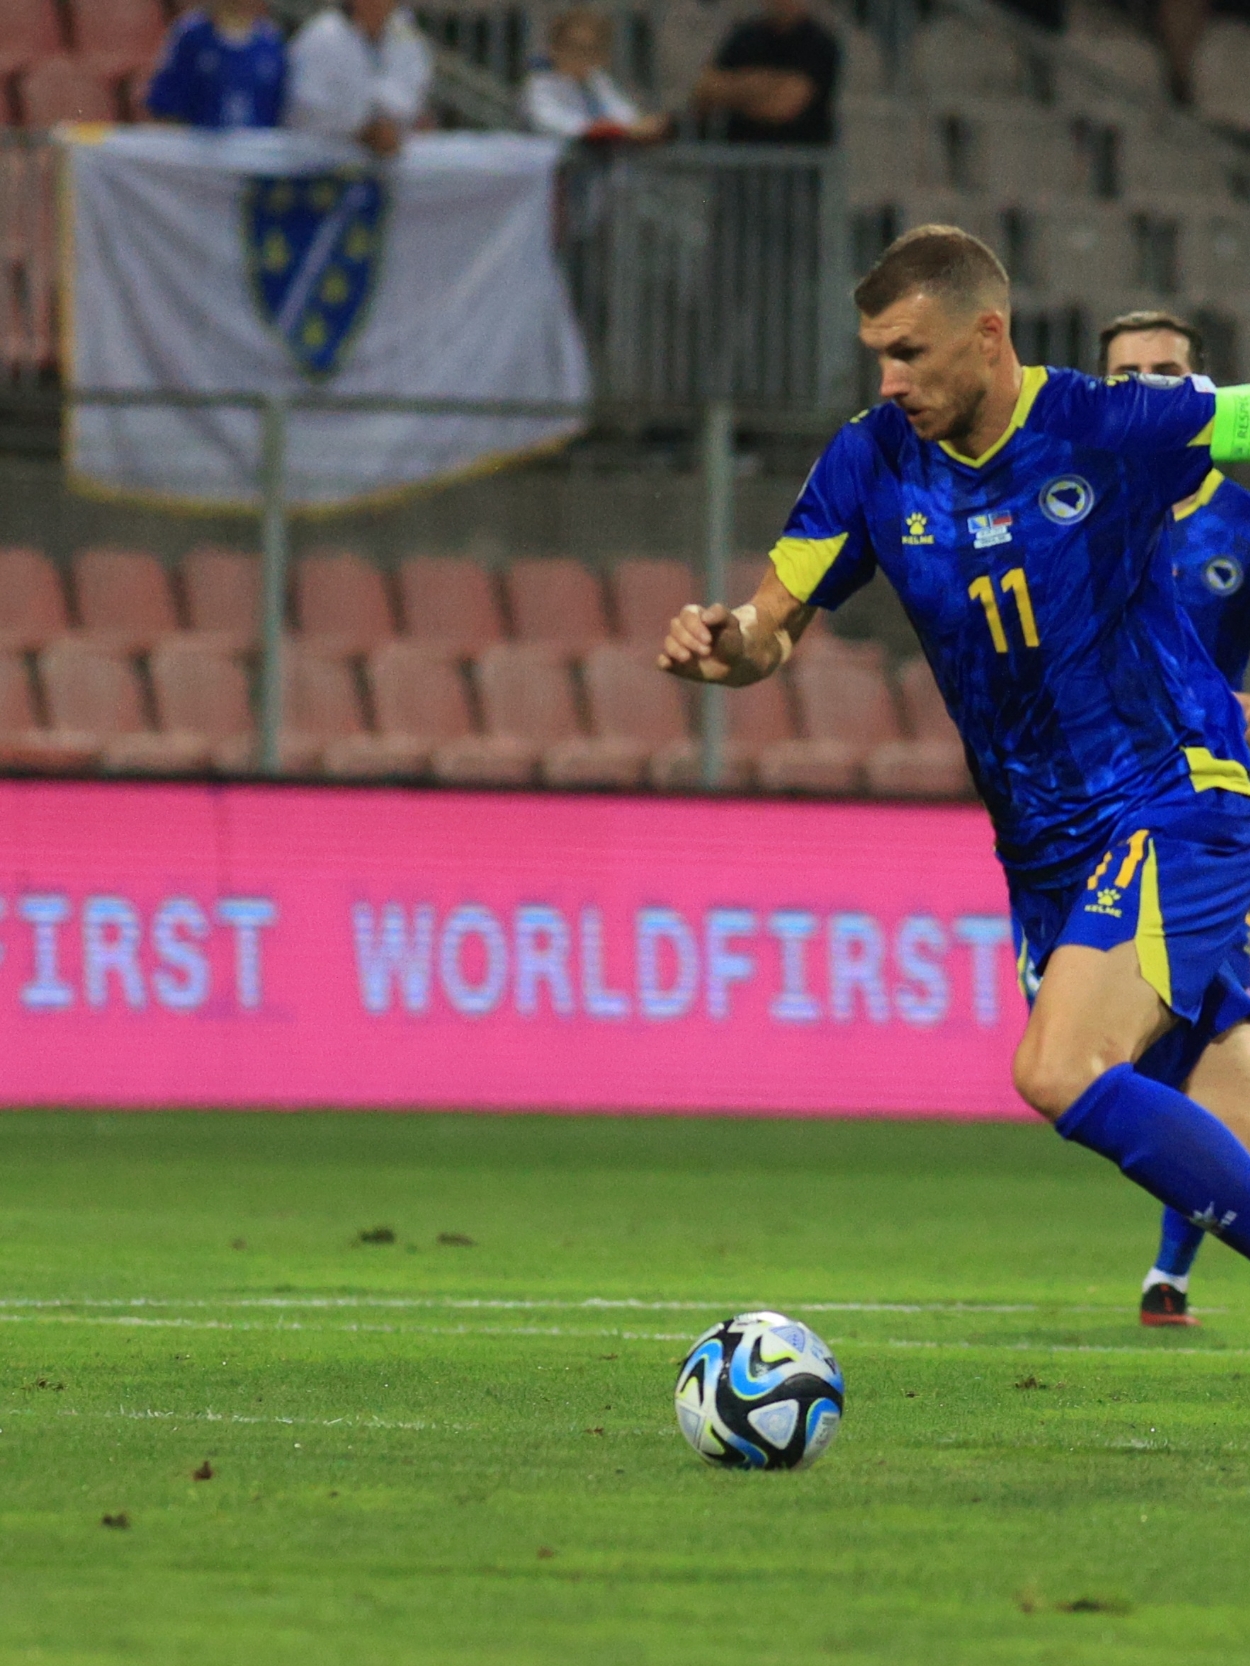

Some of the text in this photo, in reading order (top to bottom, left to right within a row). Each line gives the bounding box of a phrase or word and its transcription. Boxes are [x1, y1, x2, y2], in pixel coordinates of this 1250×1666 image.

[968, 567, 1040, 653] 11
[0, 893, 1012, 1028] IRST WORLDFIRST
